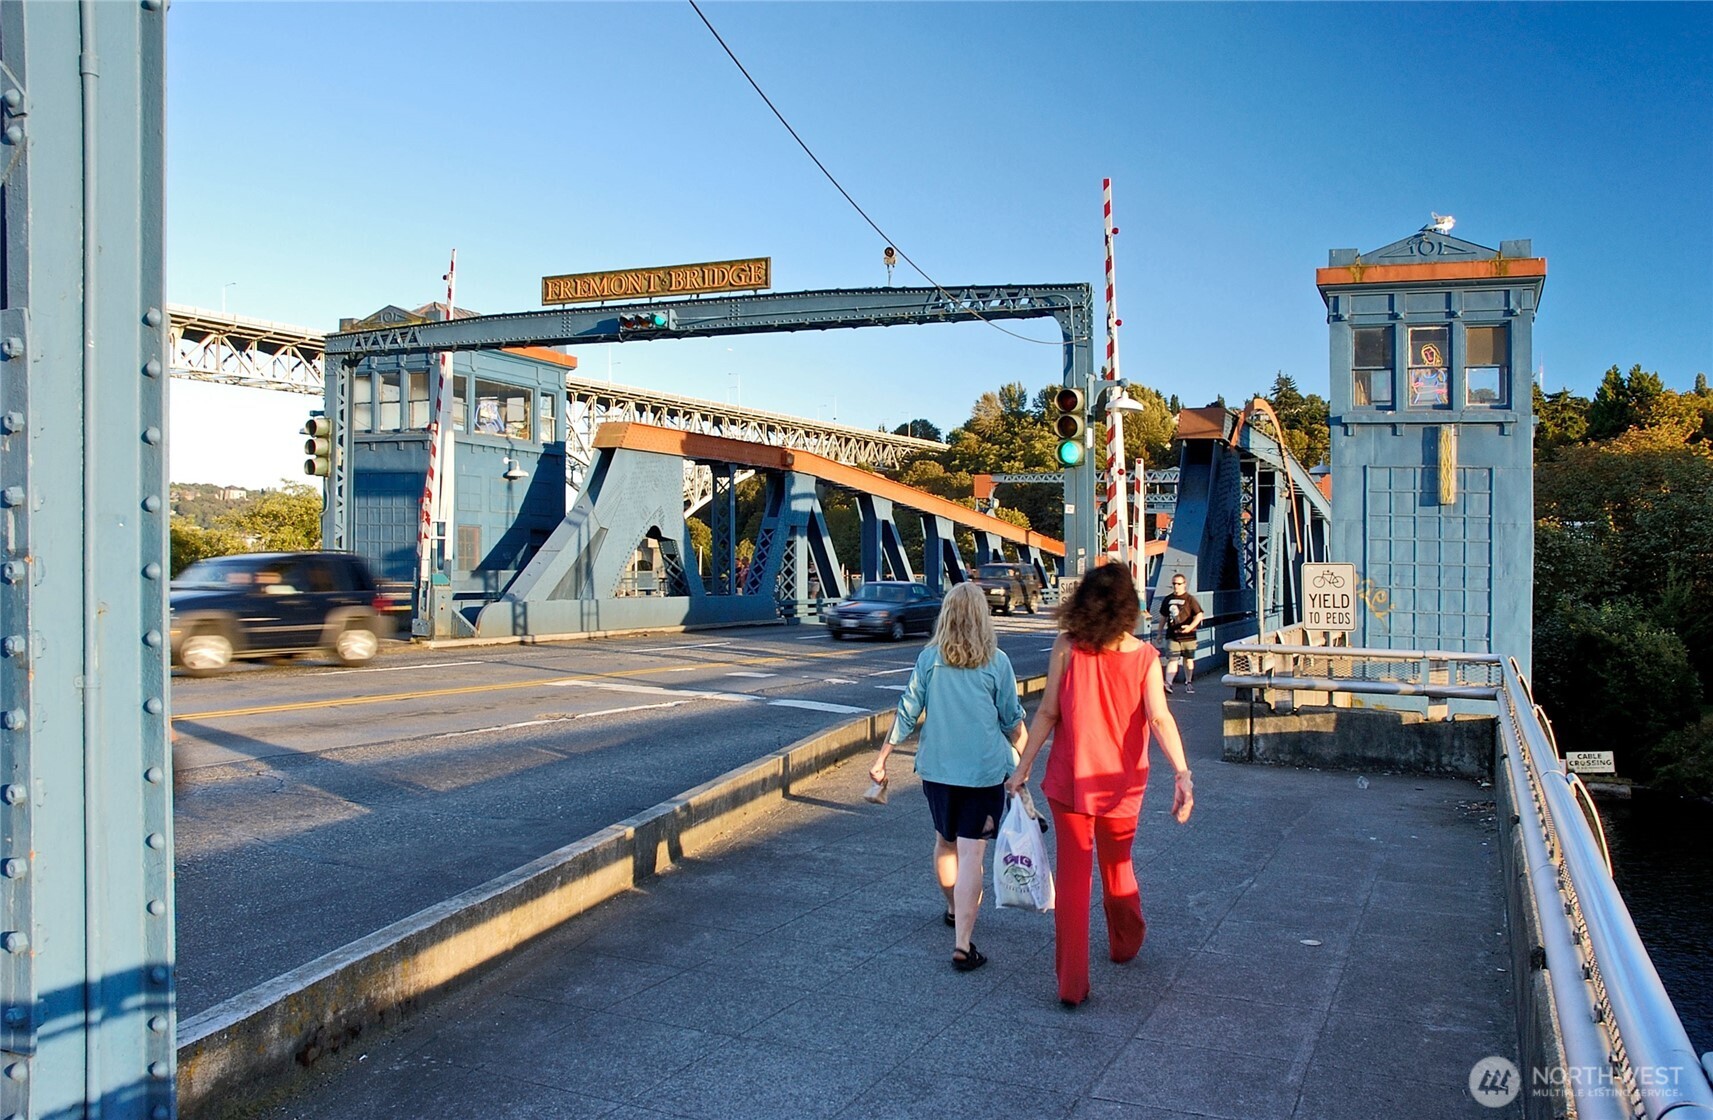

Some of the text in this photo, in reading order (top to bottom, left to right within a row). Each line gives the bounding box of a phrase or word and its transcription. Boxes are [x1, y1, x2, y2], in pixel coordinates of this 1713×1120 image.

[546, 263, 763, 300] FREMONT BRIDGE
[1309, 593, 1350, 608] YIELD
[1309, 612, 1351, 625] TO PEDS
[1568, 759, 1612, 767] CROSSING
